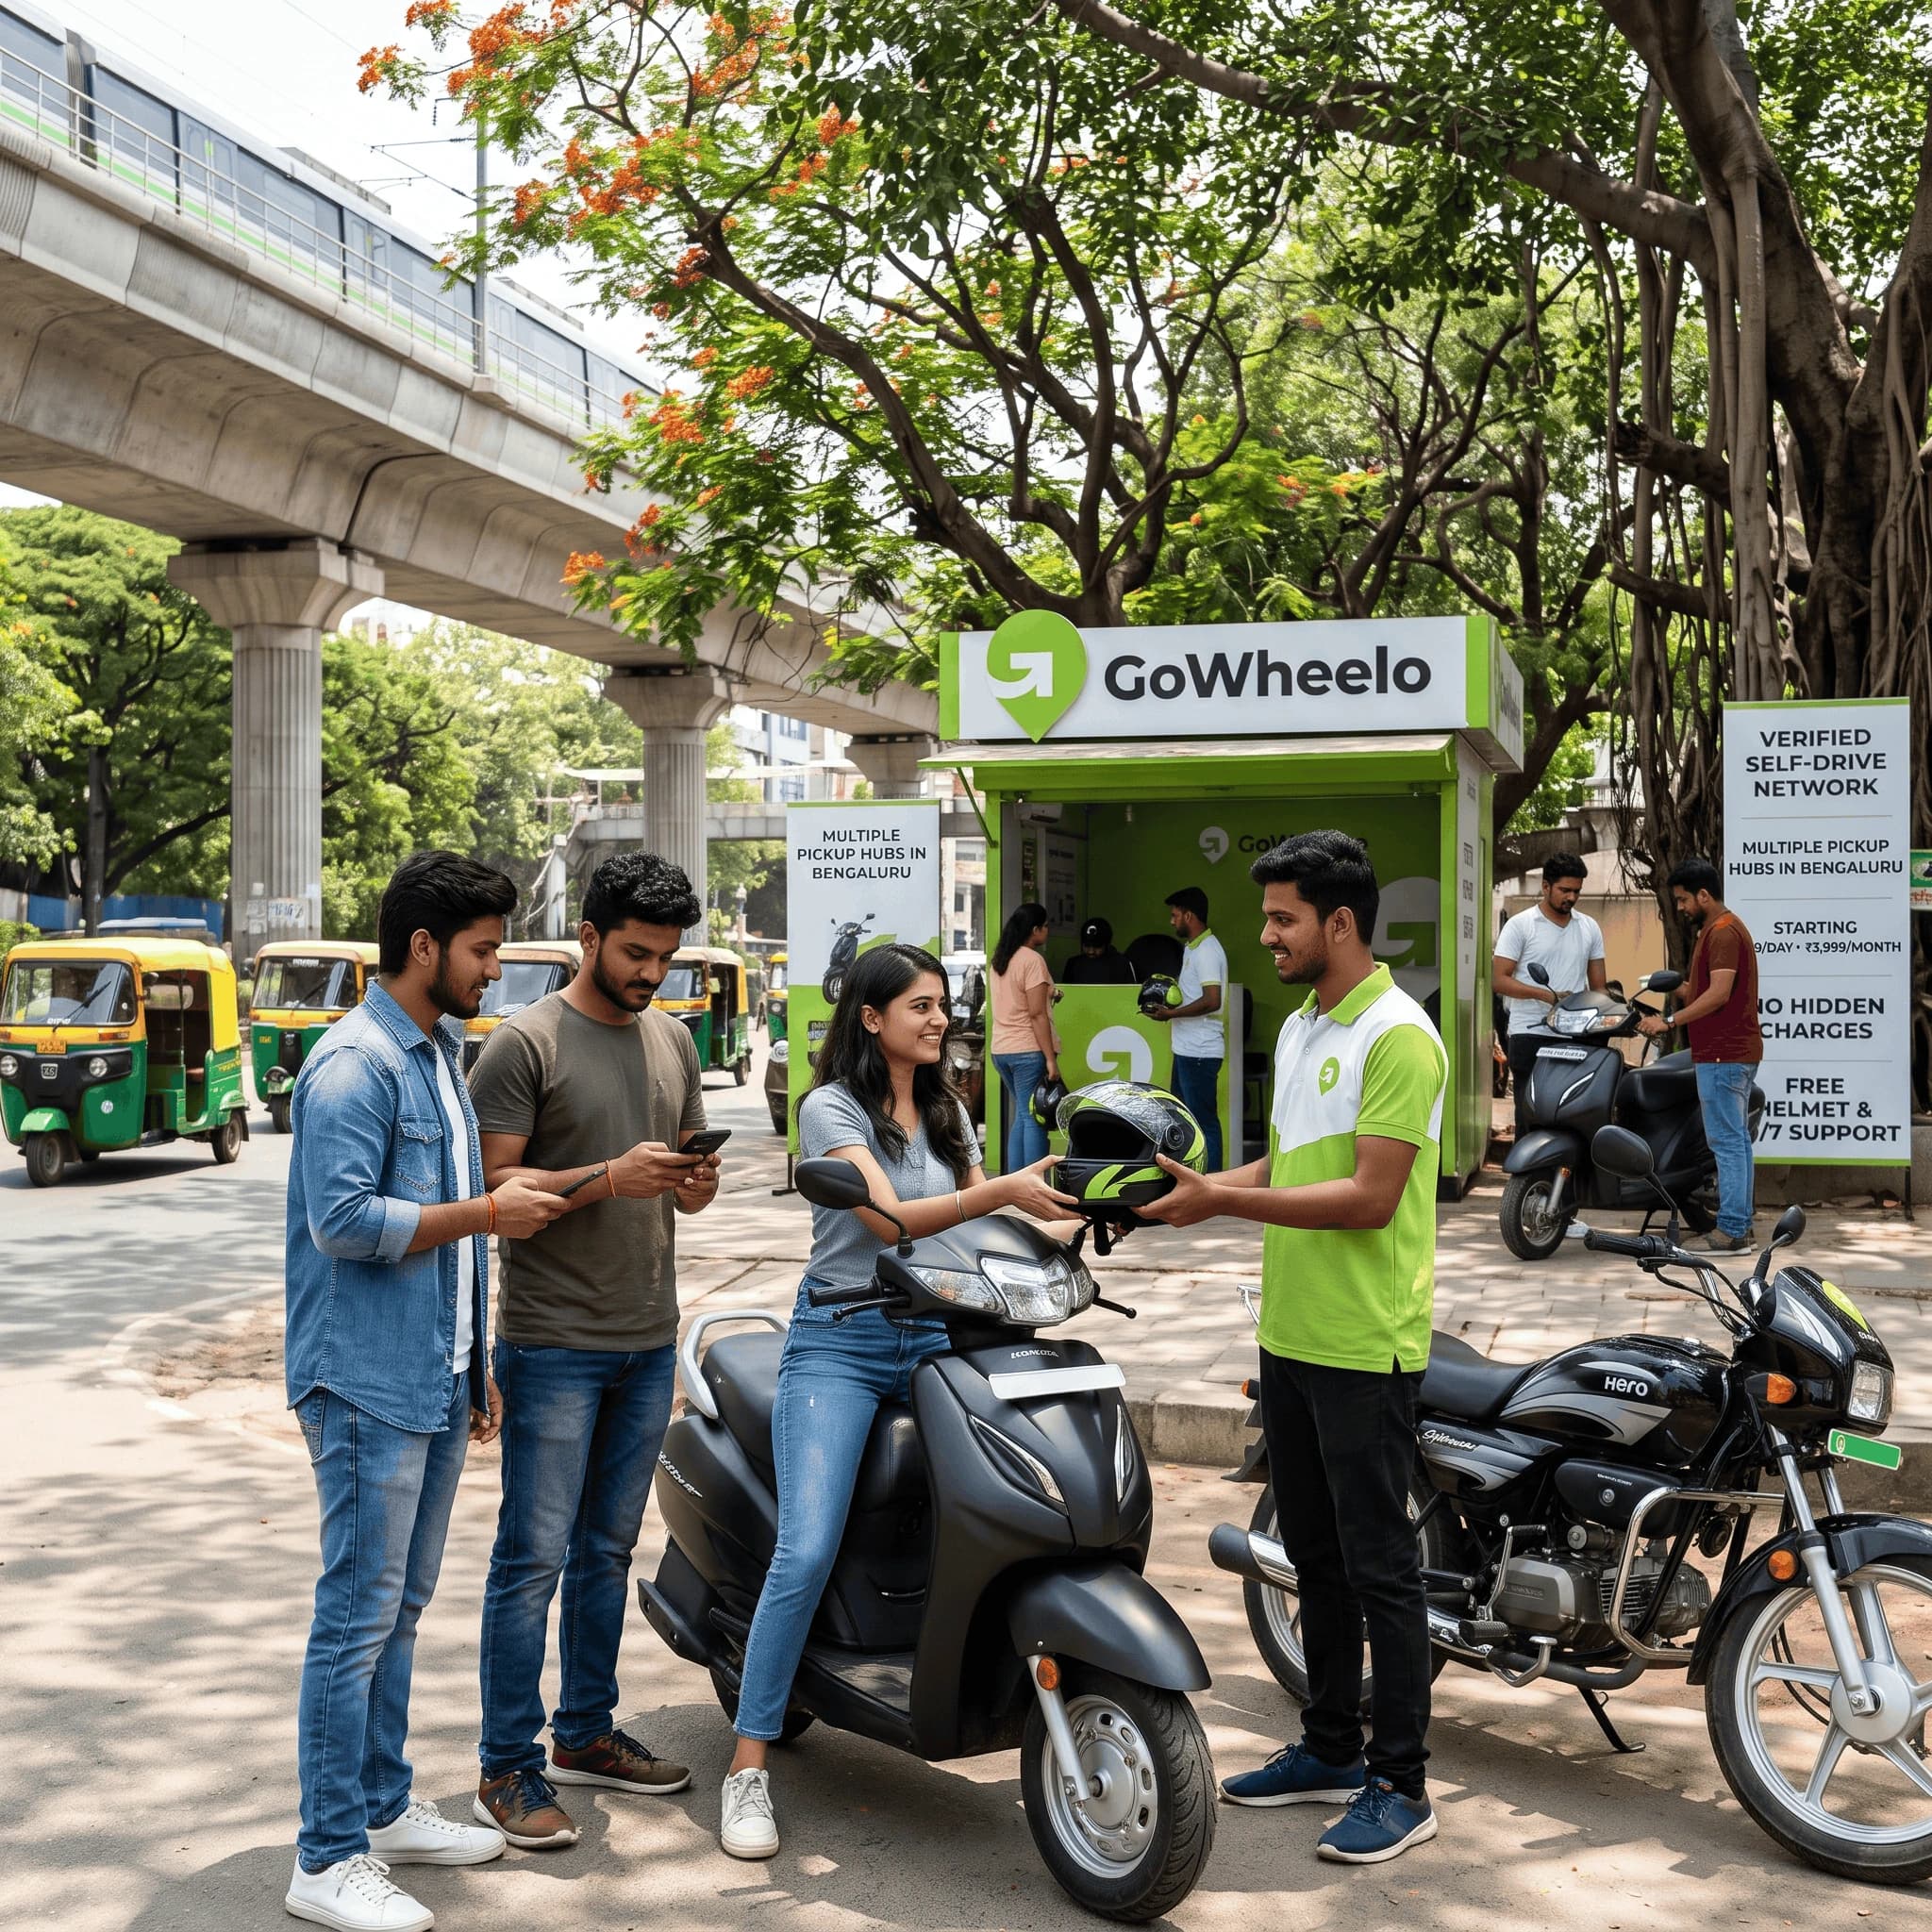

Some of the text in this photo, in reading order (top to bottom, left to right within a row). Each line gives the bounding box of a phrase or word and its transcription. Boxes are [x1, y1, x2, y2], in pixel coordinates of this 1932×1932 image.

[1105, 646, 1431, 700] GoWheelo
[1760, 729, 1871, 747] VERIFIED
[1746, 753, 1886, 772] SELF-DRIVE
[1755, 778, 1878, 797] NETWORK
[824, 829, 900, 841] MULTIPLE
[798, 847, 925, 860] PICKUP HUBS IN
[1743, 840, 1889, 854] MULTIPLE PICKUP
[813, 867, 910, 878] BENGALURU
[1730, 860, 1902, 874] HUBS IN BENGALURU
[1774, 921, 1857, 934] STARTING
[1755, 941, 1901, 954] 9/DAY ₹3,999/MONTH
[1791, 998, 1884, 1014] HIDDEN
[1759, 1023, 1873, 1039] CHARGES
[1787, 1078, 1843, 1094] FREE
[1857, 1102, 1872, 1118] &
[1759, 1122, 1901, 1141] /7 SUPPORT
